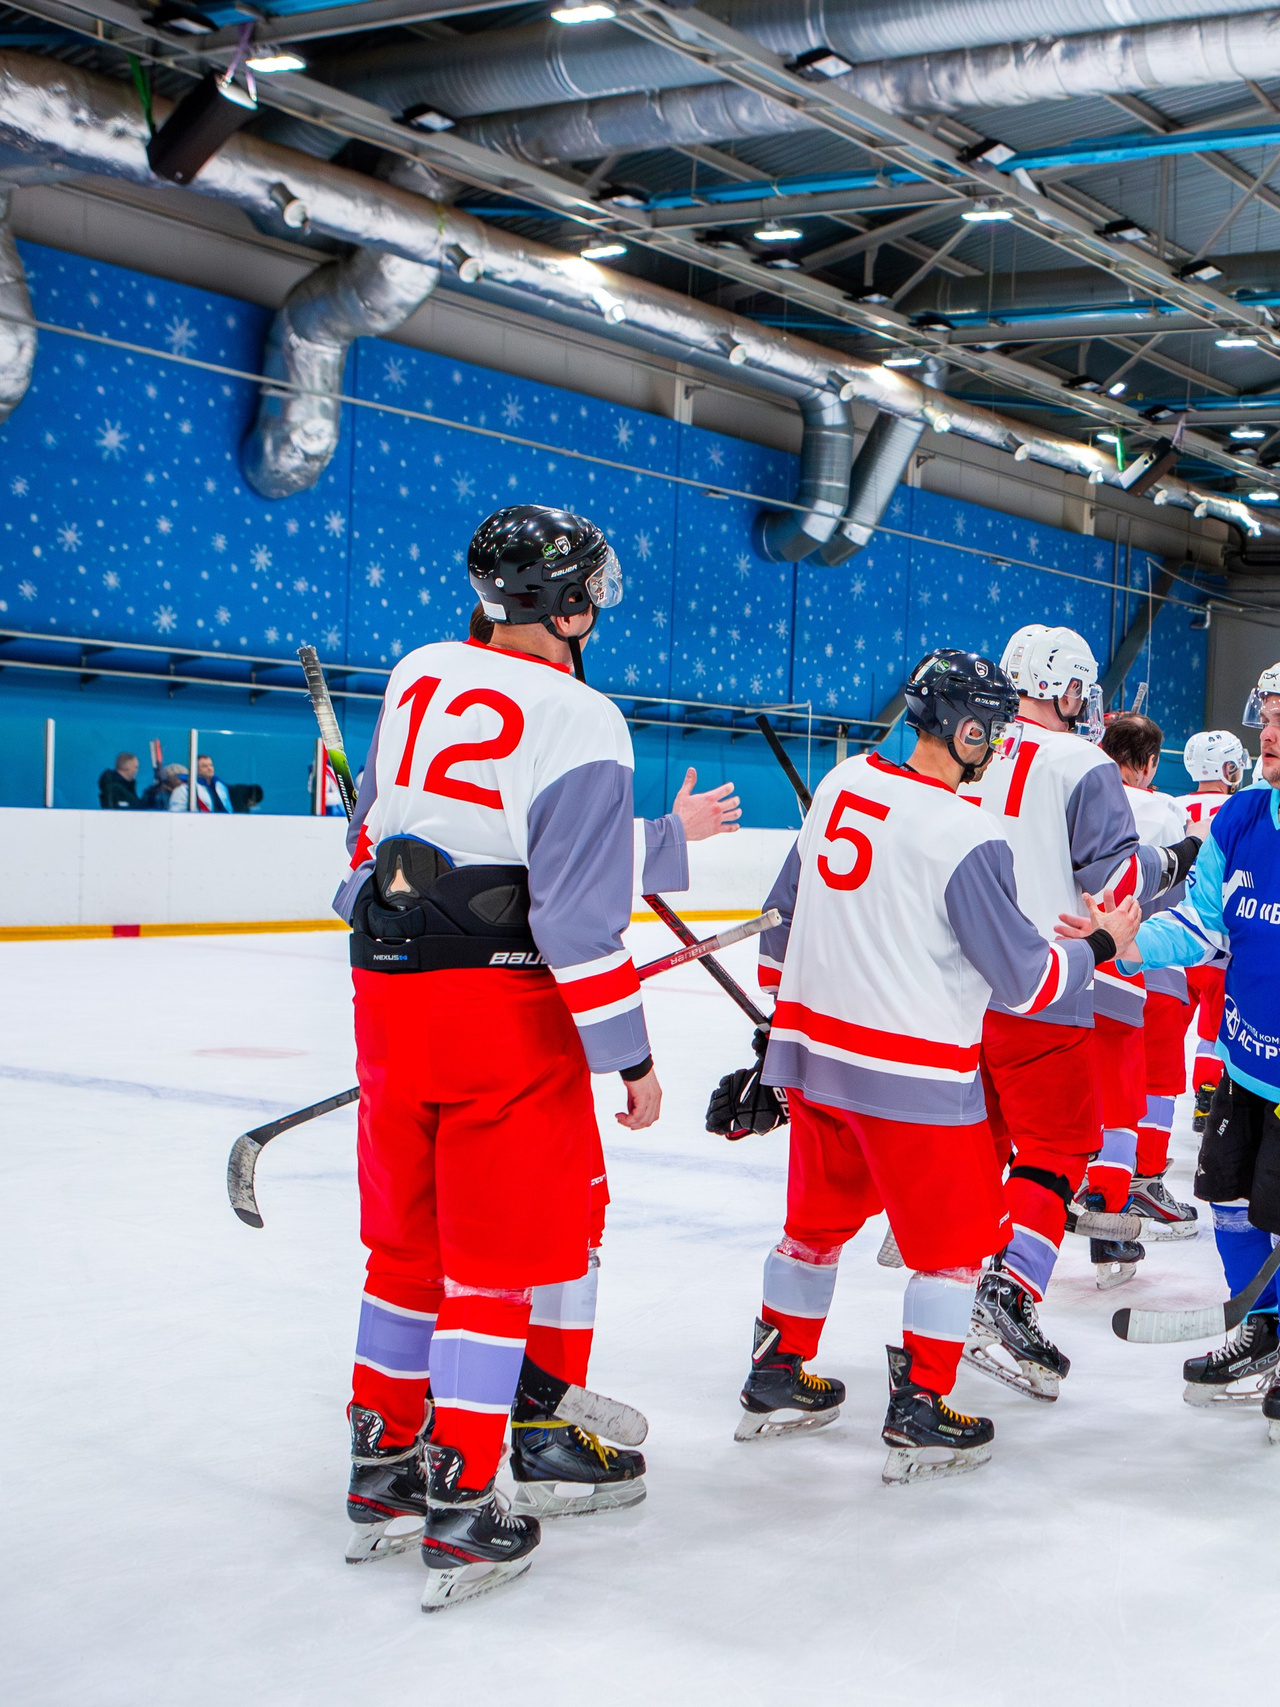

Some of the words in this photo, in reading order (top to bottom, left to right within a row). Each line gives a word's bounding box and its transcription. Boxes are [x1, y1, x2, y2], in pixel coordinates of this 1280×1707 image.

[395, 675, 525, 810] 12
[817, 789, 891, 891] 5
[1235, 896, 1258, 919] АО
[1232, 1352, 1280, 1378] VAPO
